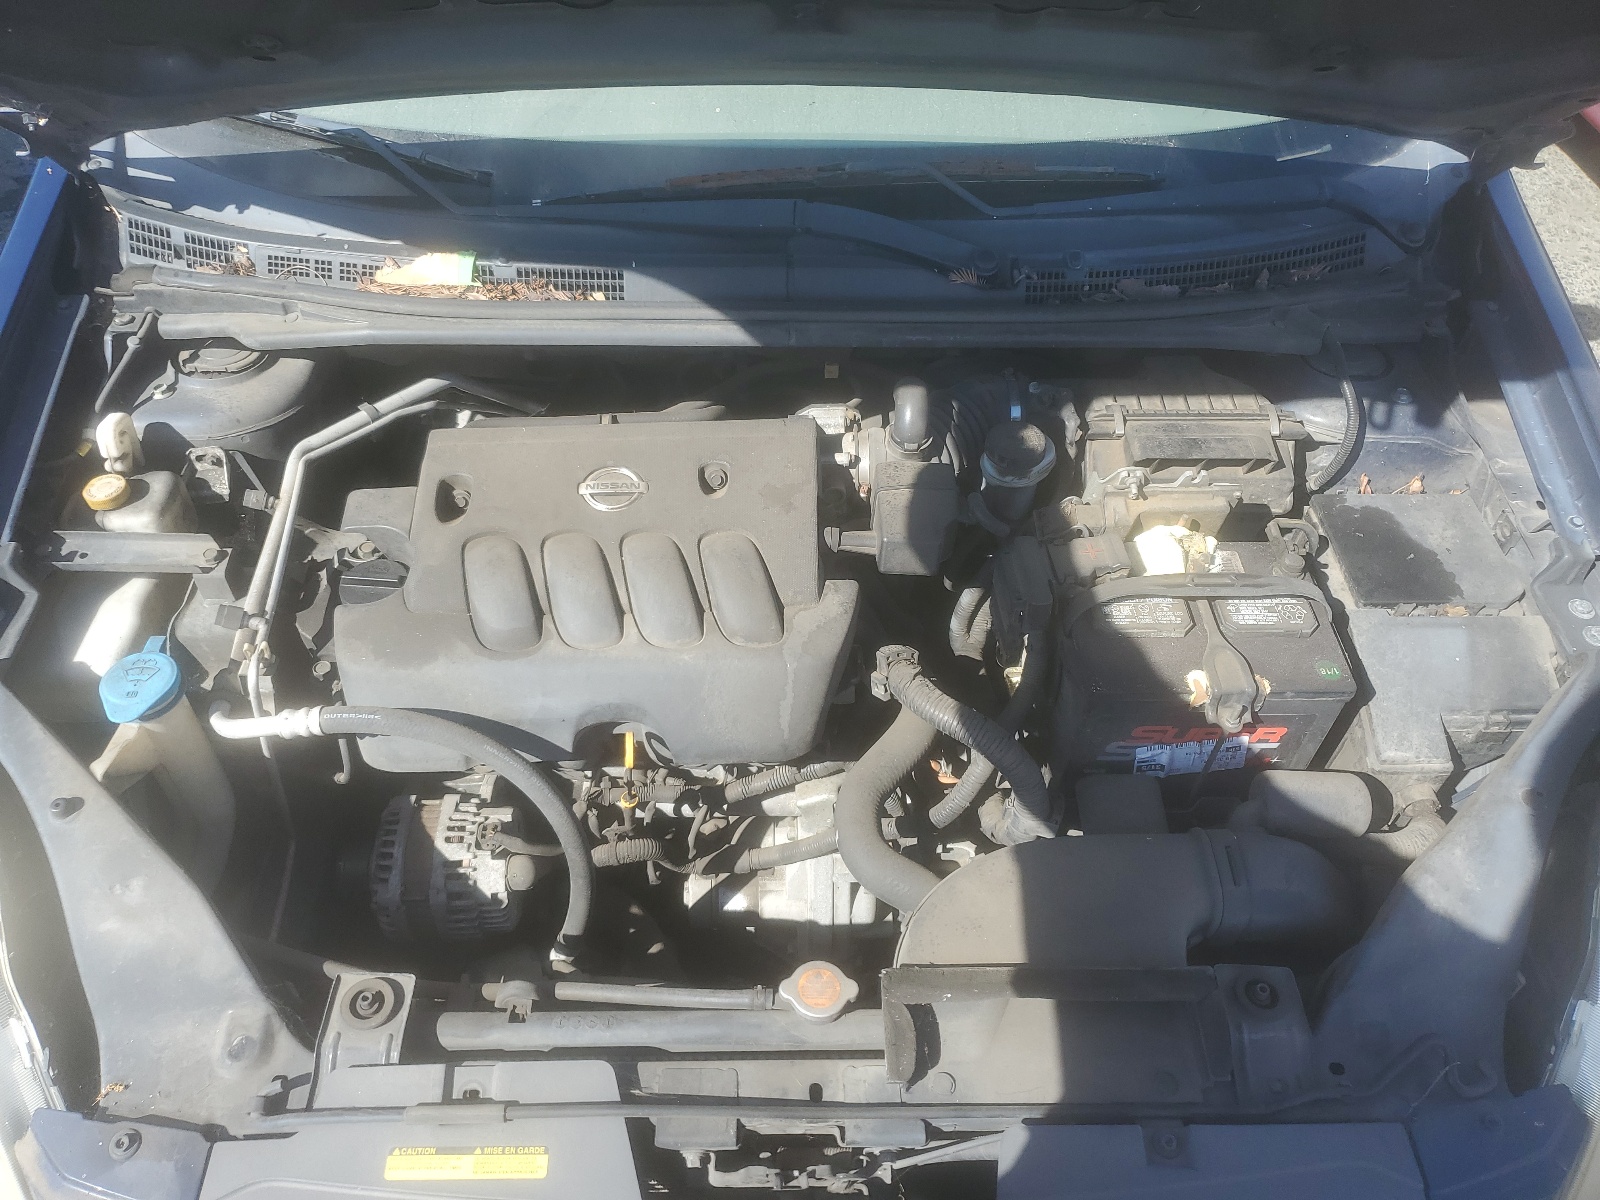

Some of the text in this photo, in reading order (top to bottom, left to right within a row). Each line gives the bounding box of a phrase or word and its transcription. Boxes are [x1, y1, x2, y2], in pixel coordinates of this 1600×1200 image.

[585, 482, 640, 490] NISSAN
[1126, 725, 1288, 744] SUPR
[400, 1147, 437, 1155] CAUTION
[484, 1146, 546, 1155] MISE EN GARDE
